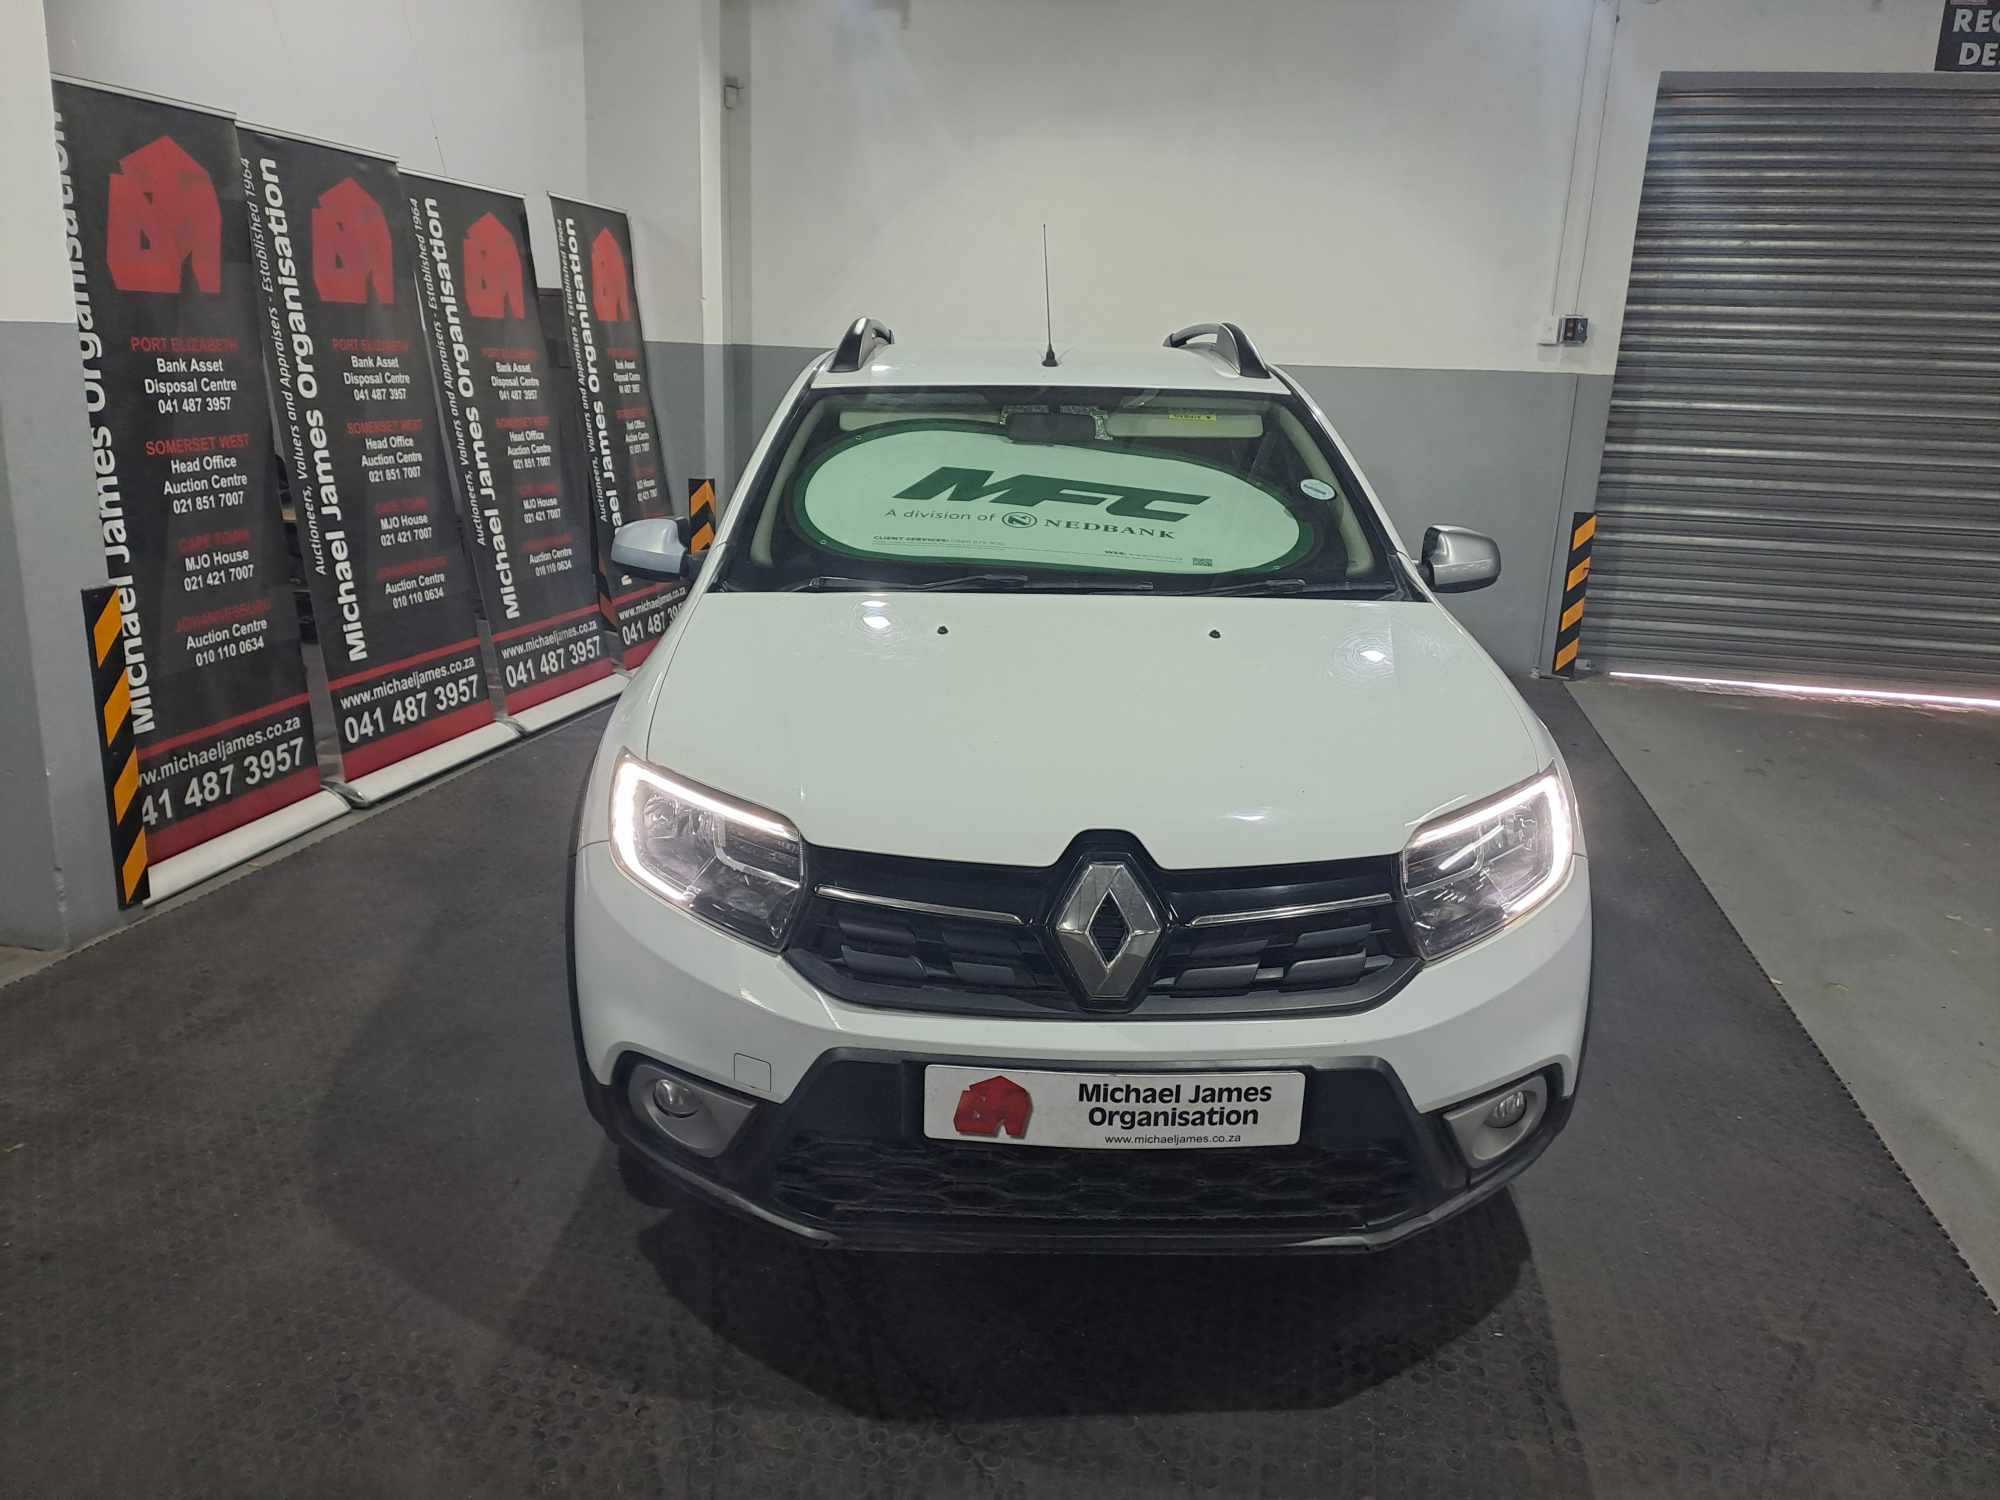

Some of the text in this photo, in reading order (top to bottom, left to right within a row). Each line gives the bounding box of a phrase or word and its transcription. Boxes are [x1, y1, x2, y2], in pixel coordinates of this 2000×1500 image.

[1959, 42, 2000, 66] DE
[250, 200, 274, 293] Established
[415, 233, 437, 310] Established
[565, 218, 600, 394] Organisation
[130, 336, 167, 352] PORT
[268, 306, 292, 388] Appraisers
[433, 321, 453, 389] Appraisers
[156, 358, 224, 373] Bank Asset
[351, 355, 399, 368] Bank Asset
[144, 377, 237, 396] Disposal Centre
[343, 372, 410, 386] Disposal Centre
[158, 397, 231, 414] 041 487 3957
[281, 390, 297, 421] and
[353, 389, 370, 400] 041
[371, 388, 386, 400] 487
[447, 389, 459, 417] and
[259, 157, 368, 663] Michael James Organisation
[425, 198, 520, 619] Michael James Organisation
[145, 437, 216, 456] SOMERSET
[289, 424, 309, 480] Valuers
[365, 435, 414, 450] Head Office
[452, 419, 468, 466] Valuers
[593, 400, 616, 483] James
[170, 455, 237, 474] Head Office
[361, 451, 422, 467] Auction Centre
[163, 473, 248, 495] Auction Centre
[369, 469, 384, 482] 021
[172, 491, 244, 514] 021 851 7007
[892, 466, 1211, 523] MFC
[380, 514, 428, 530] MJO House
[884, 508, 897, 518] A
[904, 508, 971, 521] division
[977, 511, 996, 522] of
[1044, 518, 1175, 540] NEDBANK
[380, 533, 395, 547] 021
[397, 530, 411, 543] 421
[184, 550, 249, 572] MJO House
[184, 564, 254, 592] 021 421 7007
[385, 573, 445, 594] Auction Centre
[409, 591, 422, 604] 110
[424, 587, 444, 601] 0634
[186, 618, 268, 650] Auction Centre
[501, 620, 598, 659] www.michaeljames.co.za
[622, 620, 644, 645] 041
[647, 611, 666, 634] 487
[195, 635, 265, 667] 010 110 0634
[506, 635, 600, 688] 041 487 3957
[340, 656, 475, 709] www.michaeljames.co.za
[344, 674, 478, 743] 041 487 3957
[184, 763, 235, 808] 487
[243, 737, 304, 785] 3957
[1079, 1083, 1272, 1104] Michael James
[1089, 1106, 1259, 1130] Organisation
[1105, 1134, 1241, 1146] www.michaeljames.co.za
